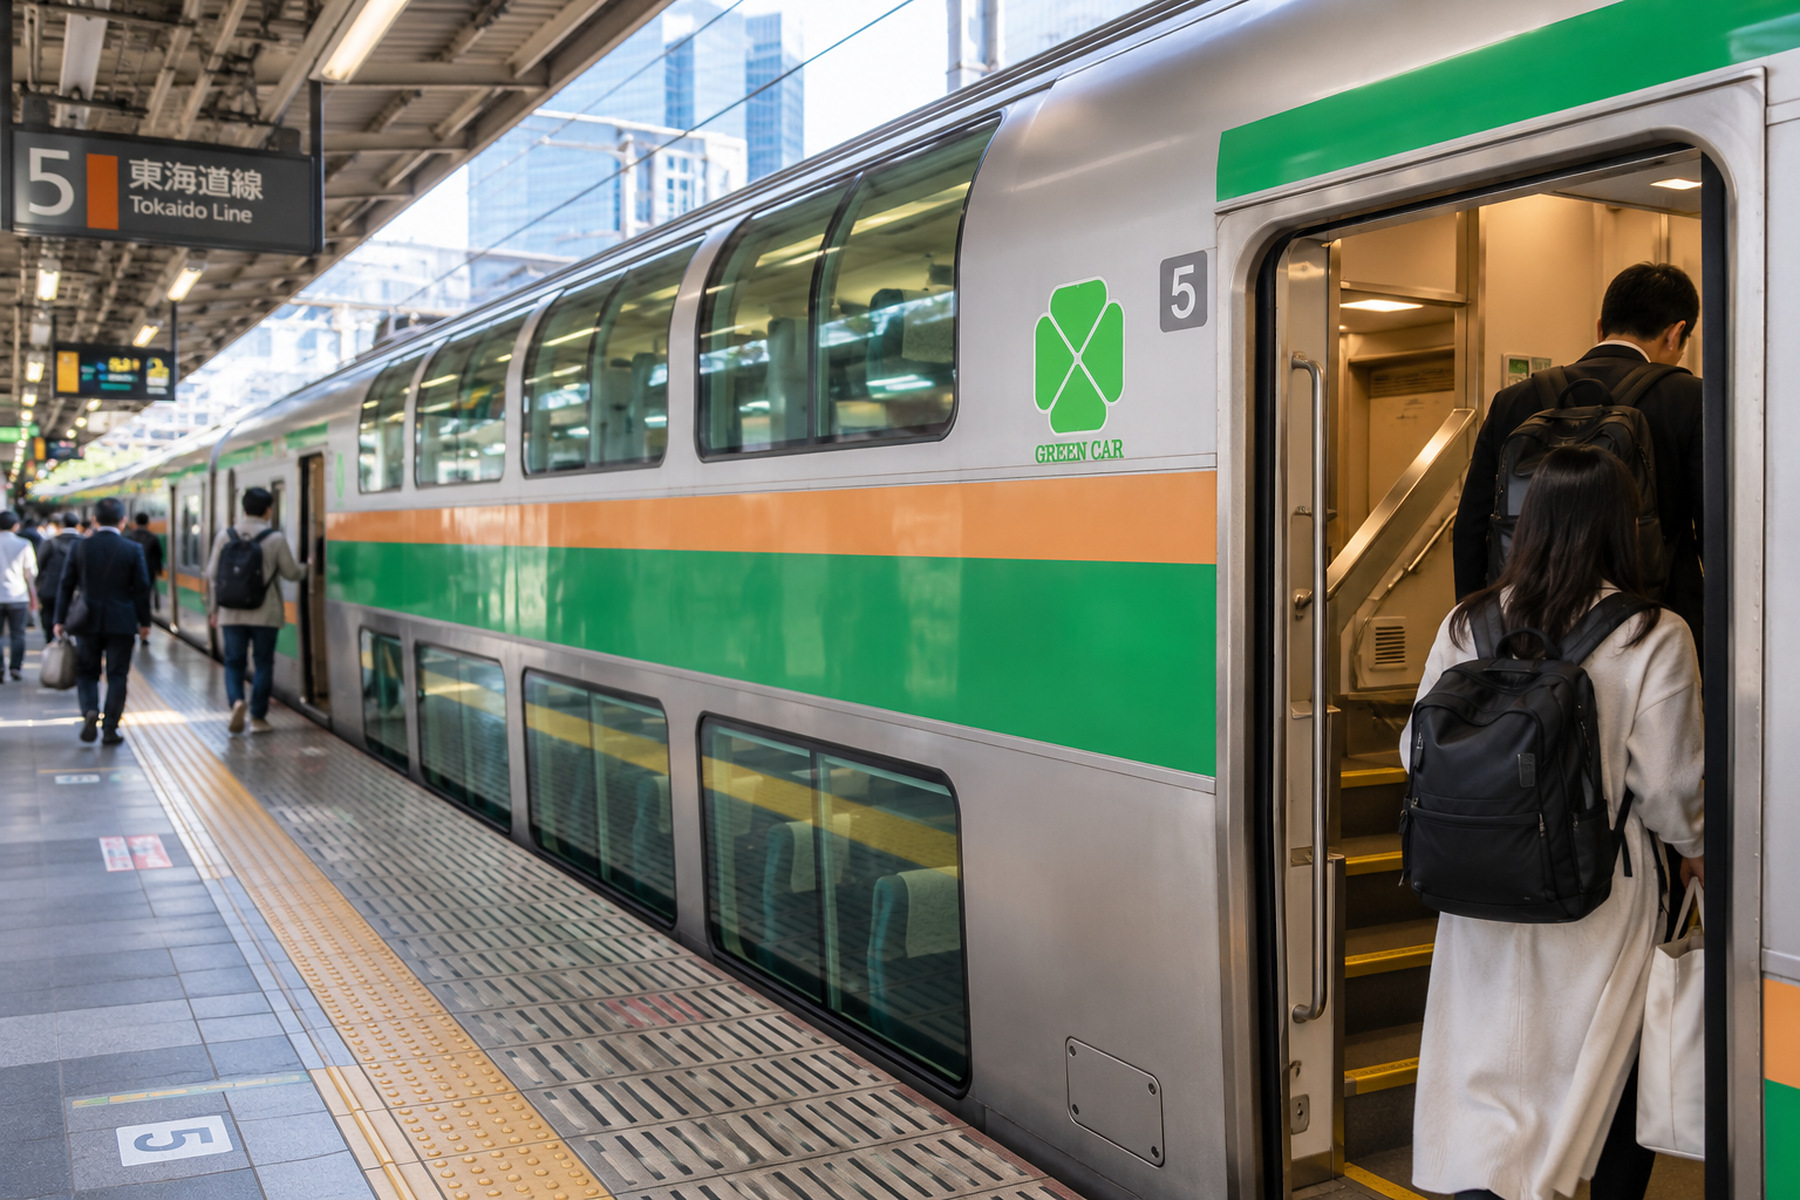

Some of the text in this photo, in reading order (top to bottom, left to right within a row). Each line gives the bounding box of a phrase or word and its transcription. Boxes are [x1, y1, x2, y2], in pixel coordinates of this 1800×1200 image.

[29, 147, 74, 216] 5
[129, 159, 263, 200] 東海道線
[129, 195, 253, 223] Tokaido Line
[1171, 264, 1196, 319] 5
[1035, 439, 1124, 463] GREEN CAR
[134, 1127, 213, 1152] 5
